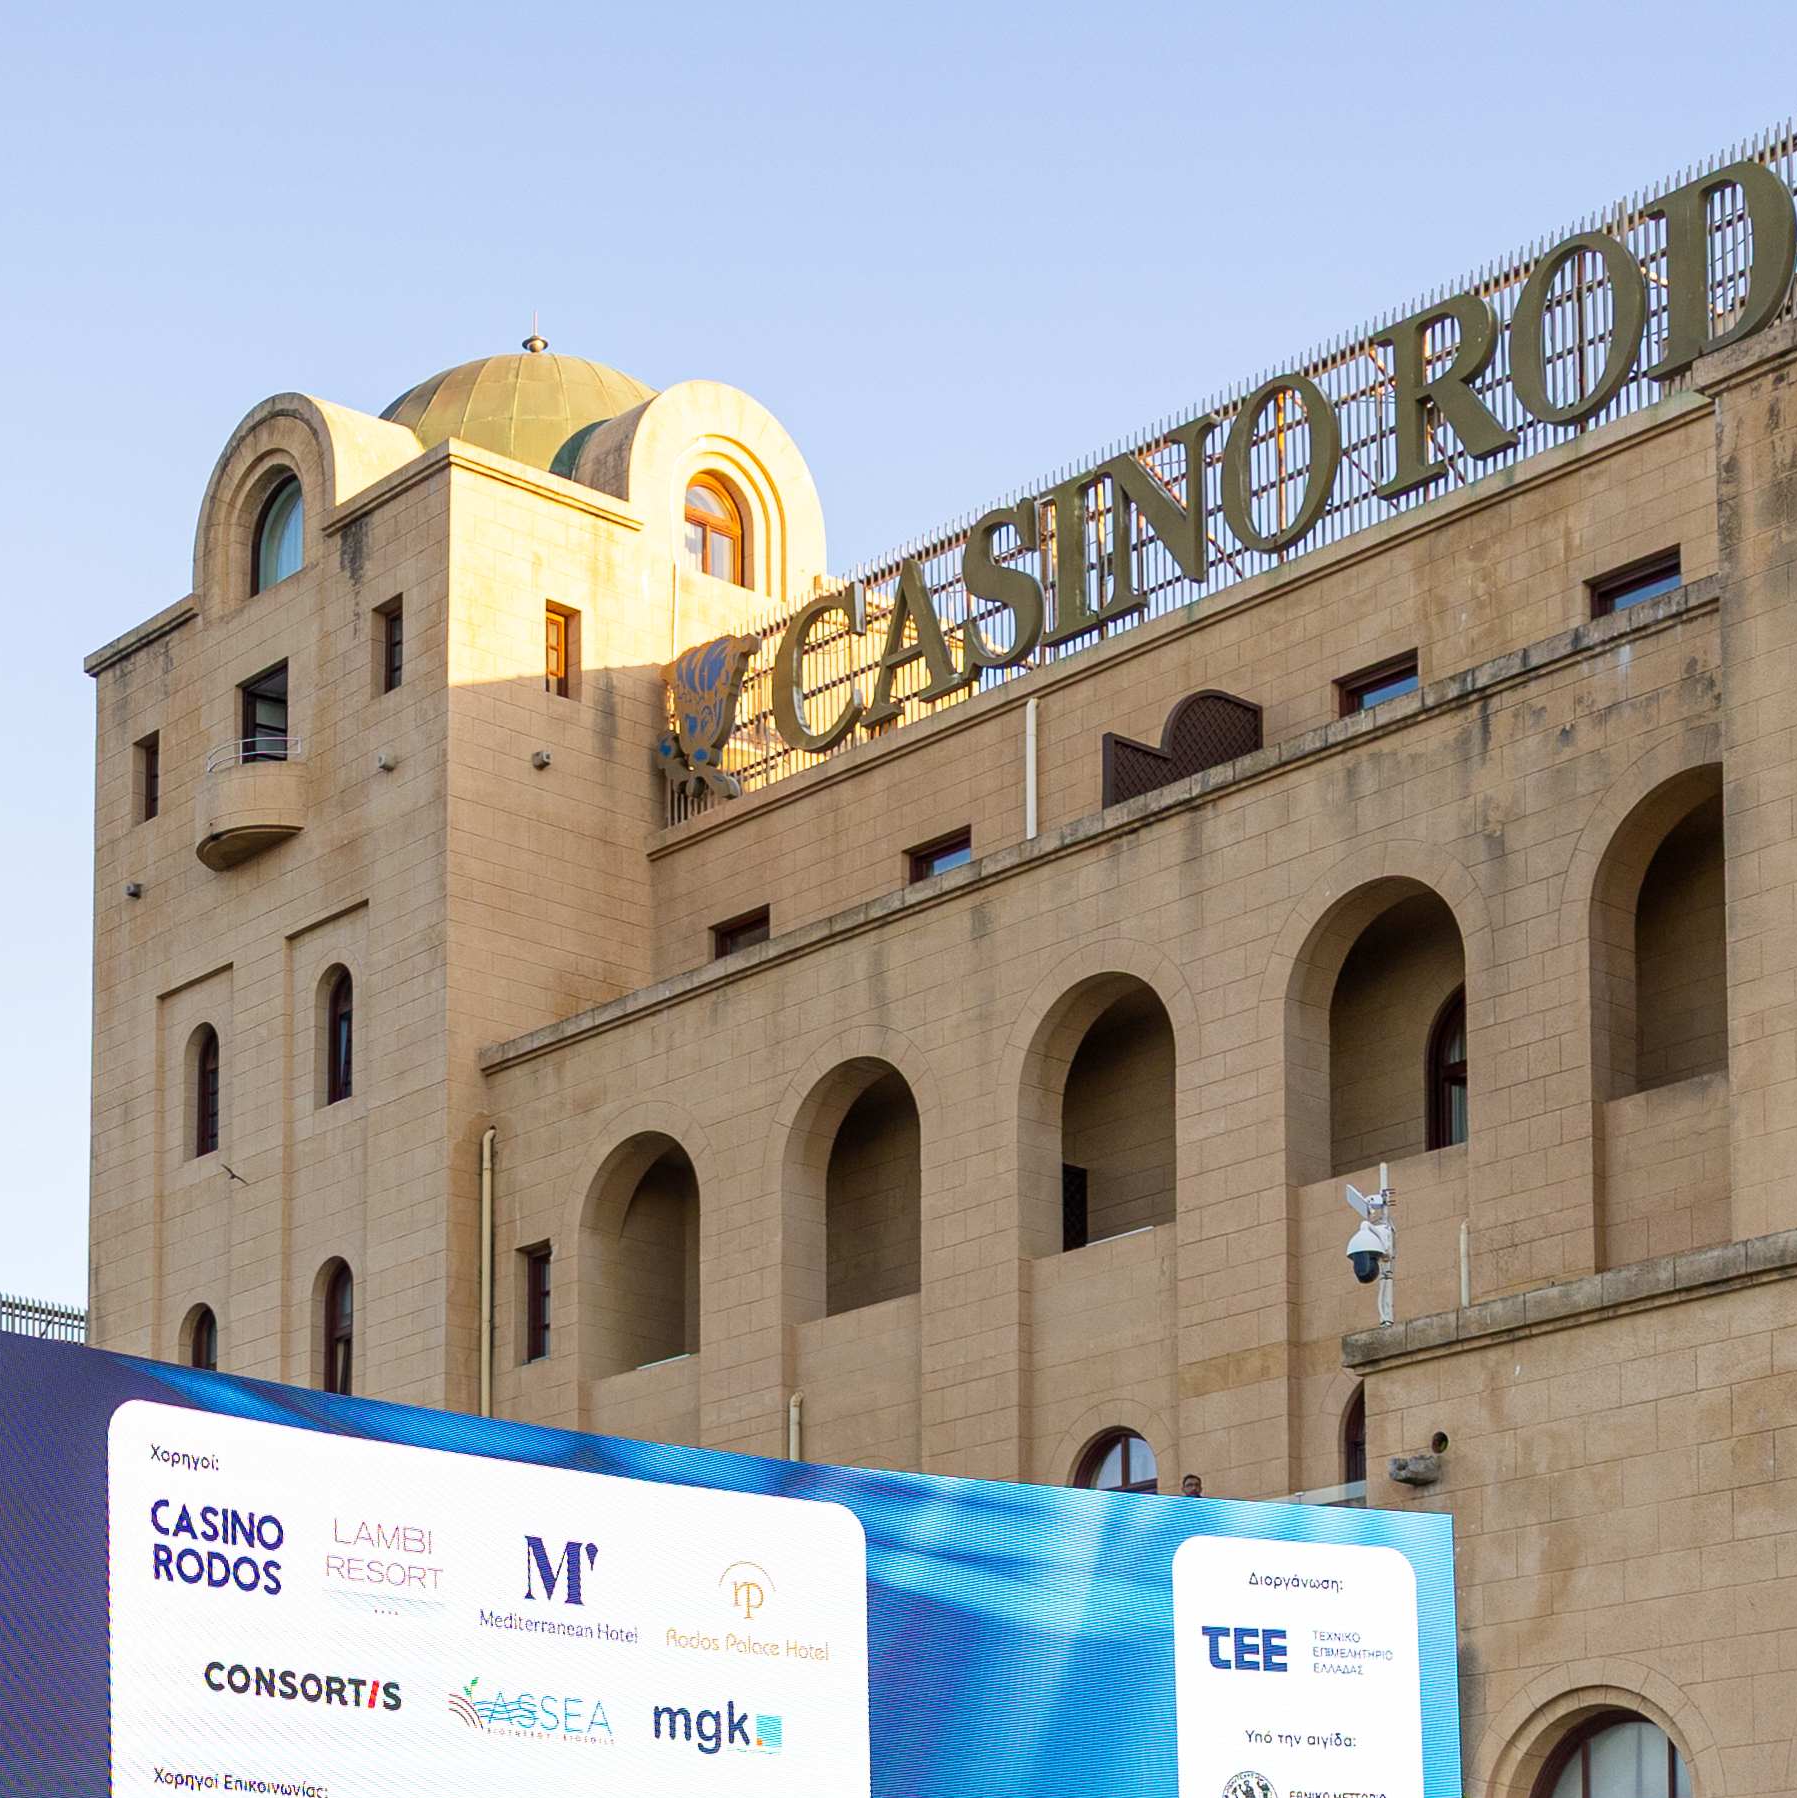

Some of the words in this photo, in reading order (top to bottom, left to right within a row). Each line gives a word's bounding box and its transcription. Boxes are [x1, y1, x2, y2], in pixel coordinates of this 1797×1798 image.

[771, 374, 1340, 753] CASINO
[150, 1444, 220, 1472] Χορηγοί:
[151, 1499, 284, 1551] CASINO
[333, 1517, 432, 1555] LAMBI
[153, 1543, 282, 1596] RODOS
[326, 1554, 444, 1590] RESORT
[1248, 1572, 1344, 1594] Διοργάνωση:
[479, 1607, 593, 1640] Mediterranean
[597, 1622, 639, 1645] Hotel
[666, 1627, 721, 1652] Rodos
[725, 1632, 781, 1658] Palace
[786, 1639, 830, 1662] Hotel
[204, 1661, 402, 1711] CONSORTIS
[1245, 1730, 1273, 1744] Υπό
[1277, 1734, 1302, 1747] την
[1307, 1731, 1357, 1750] αιγίδα:
[154, 1766, 219, 1791] Χορηγοί
